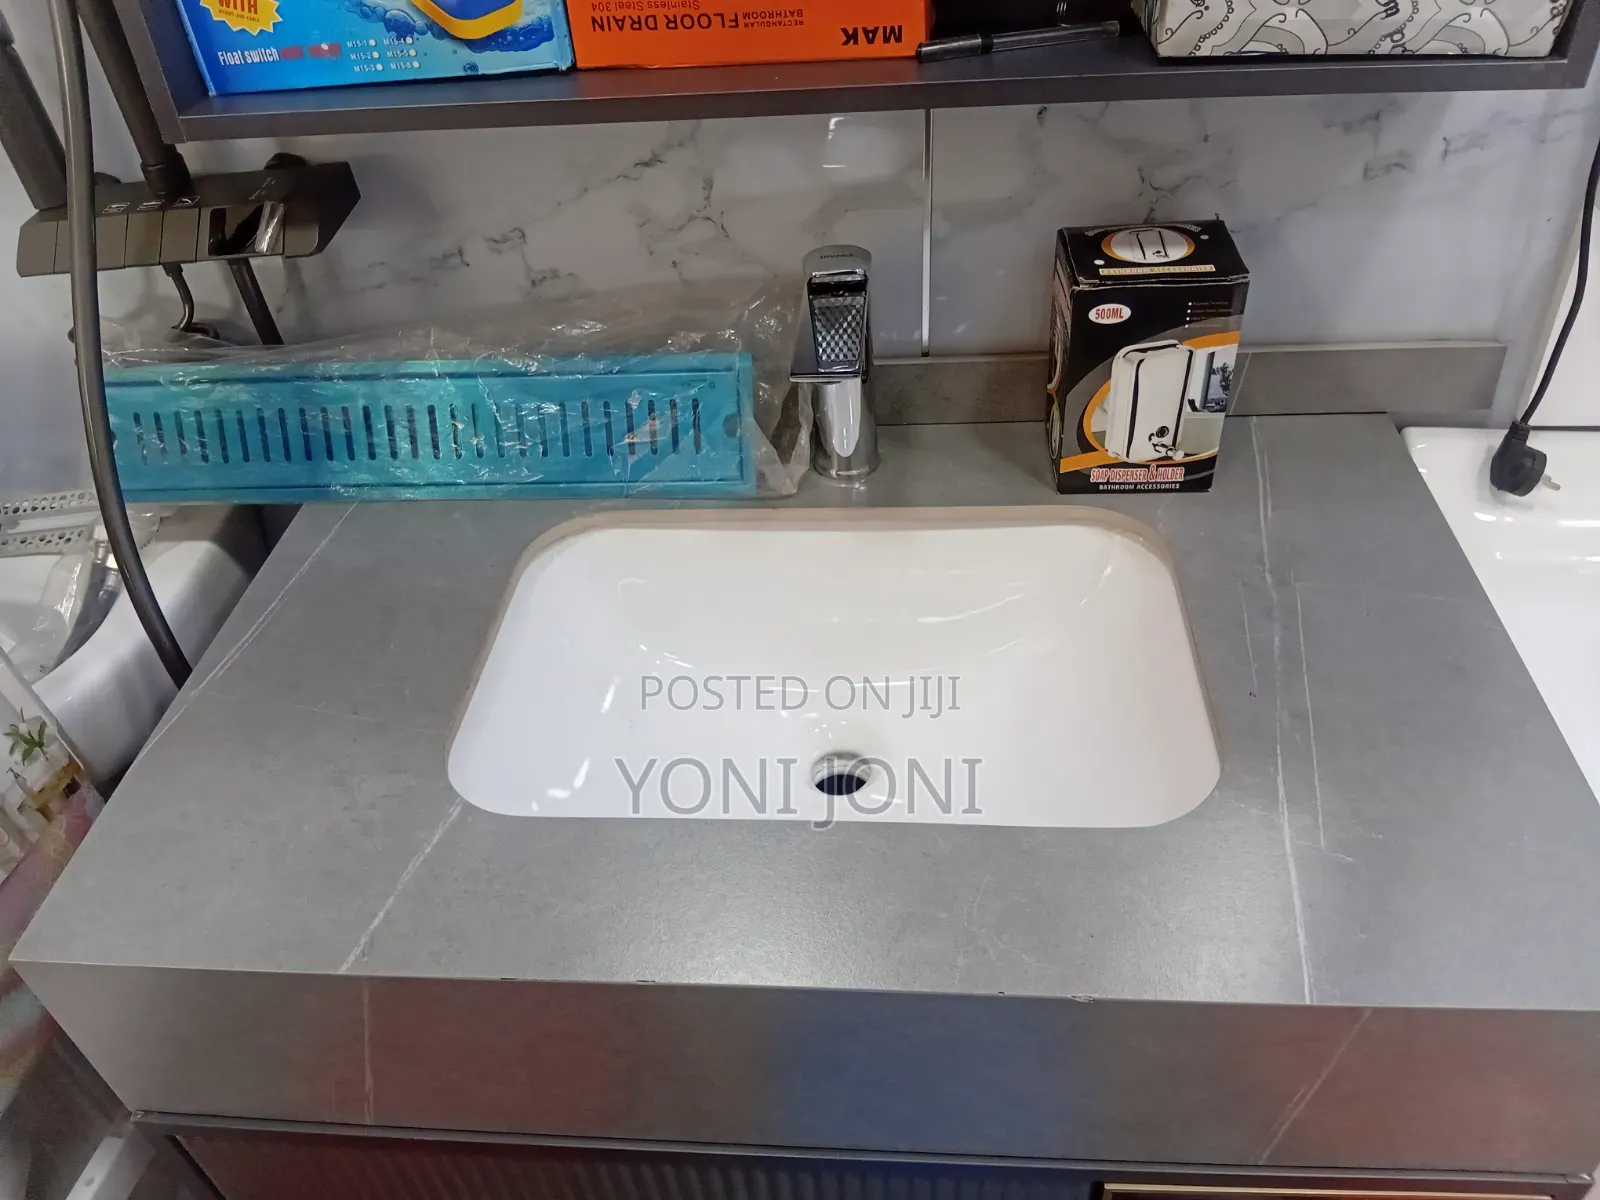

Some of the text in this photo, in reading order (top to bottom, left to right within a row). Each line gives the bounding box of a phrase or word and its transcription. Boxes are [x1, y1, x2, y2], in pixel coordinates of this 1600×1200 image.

[591, 0, 701, 12] Stainless Steel 304
[742, 9, 804, 20] BATHROOM
[591, 13, 739, 32] FLOOR DRAIN
[743, 19, 805, 28] RECTANGULAR
[840, 24, 903, 46] MAK
[347, 40, 368, 48] M15-1
[217, 46, 280, 66] Float switch
[350, 52, 372, 60] M15-2
[387, 49, 409, 58] M15-5
[353, 64, 376, 72] M15-3
[390, 61, 412, 70] M15-6
[1095, 308, 1124, 320] 500ML
[1090, 464, 1185, 482] SOAP DISPENSER & HOLDER
